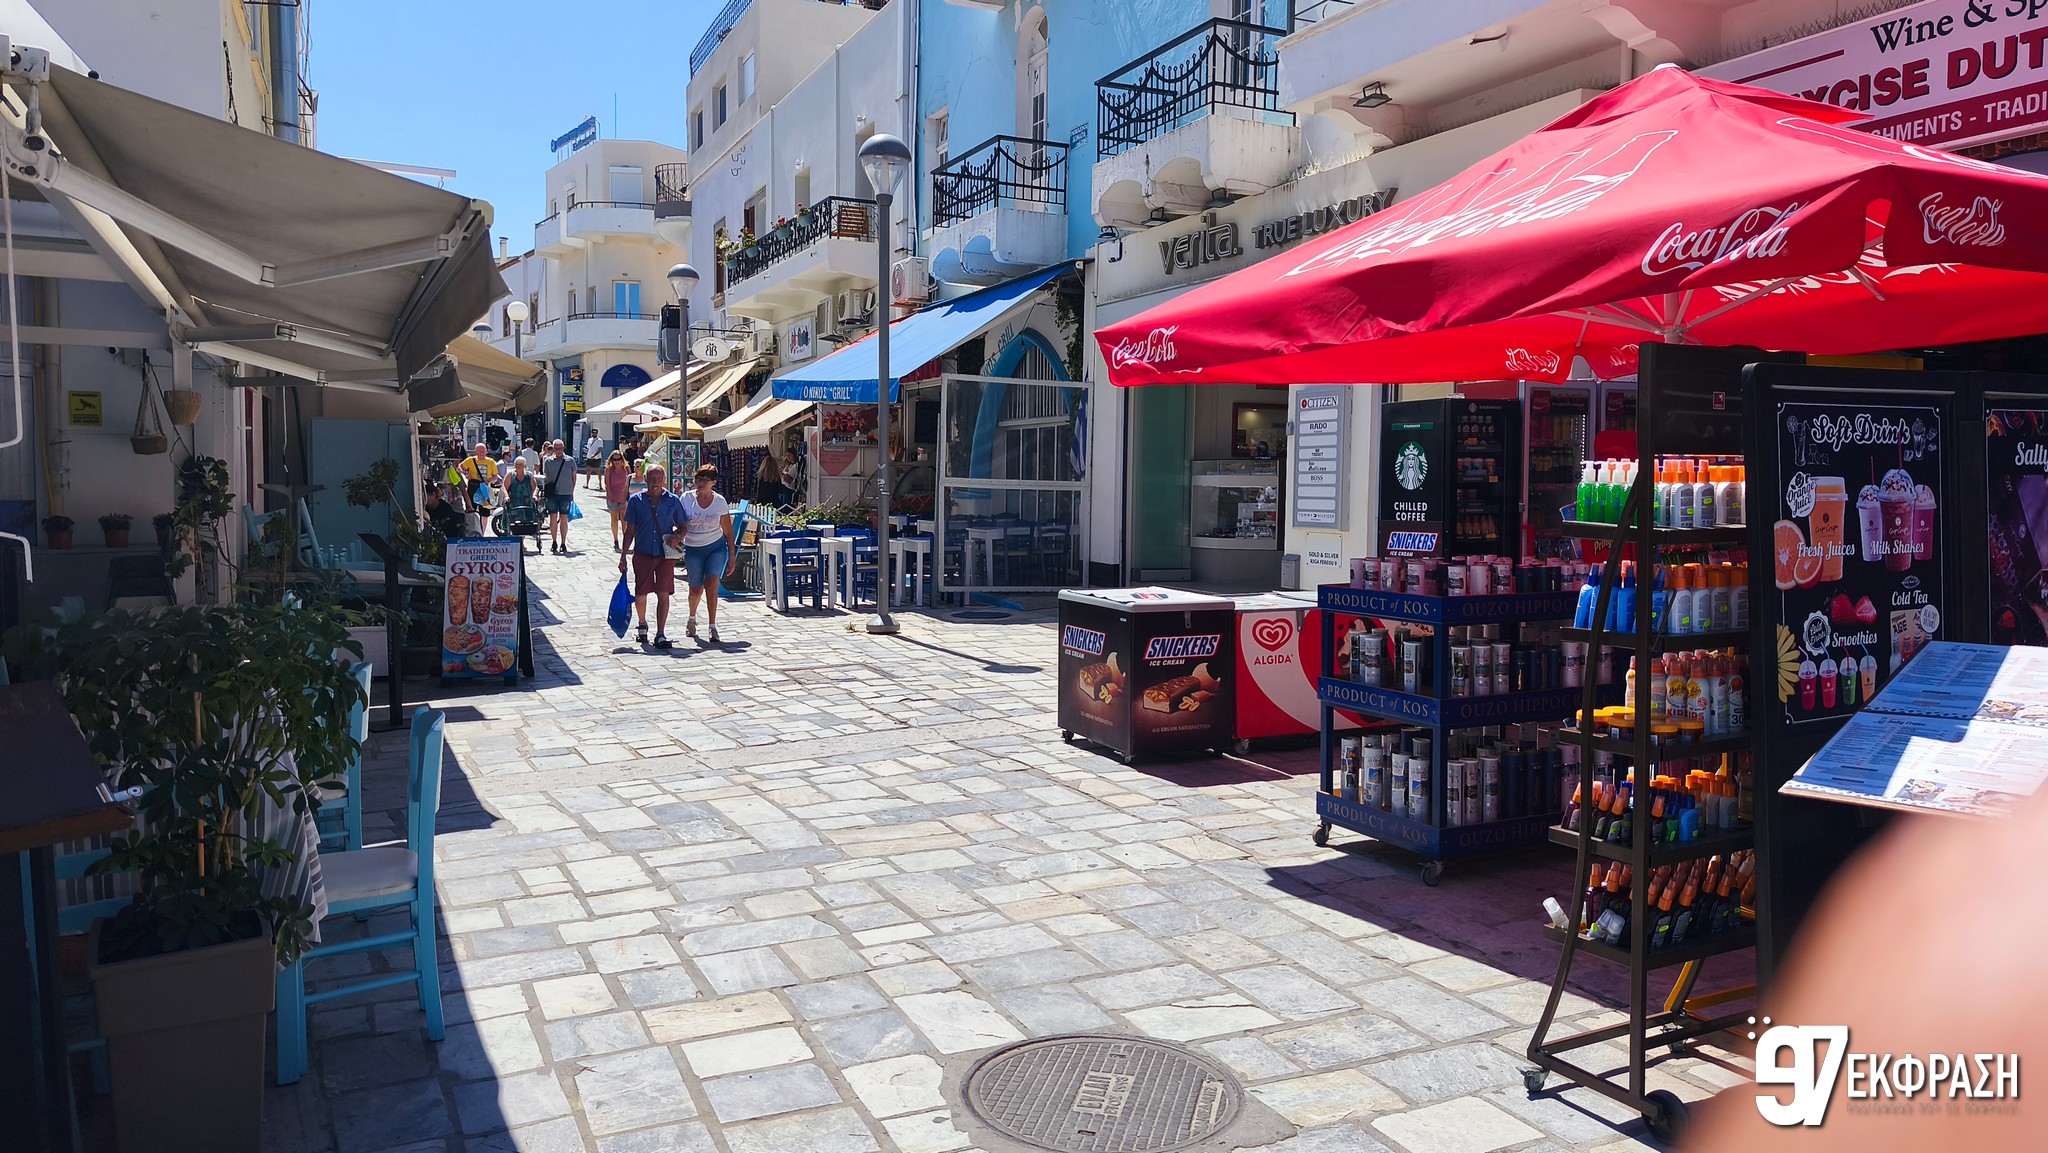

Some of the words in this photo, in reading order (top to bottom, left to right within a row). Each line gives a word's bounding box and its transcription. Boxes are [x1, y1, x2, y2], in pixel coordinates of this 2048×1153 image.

[1870, 15, 1953, 53] Wine
[1963, 0, 1997, 28] &
[1251, 216, 1300, 249] TRUE
[1302, 188, 1398, 236] LUXURY
[1642, 202, 1808, 275] Coca-Cola
[1112, 325, 1179, 369] Coca-Cola
[1308, 396, 1337, 408] CITIZEN
[1811, 414, 1853, 452] Soft
[1854, 413, 1911, 445] Drink
[1789, 480, 1816, 502] Orange
[1394, 501, 1428, 511] CHILLED
[1793, 493, 1812, 515] Juice
[1395, 512, 1426, 522] COFFEE
[1389, 532, 1436, 551] SNICKERS
[1797, 542, 1824, 557] Fresh
[1826, 541, 1855, 560] Juices
[1870, 540, 1891, 555] Milk
[1892, 539, 1924, 555] Shakes
[457, 547, 510, 555] TRADITIONAL
[451, 561, 515, 575] GYROS
[1327, 592, 1387, 611] PRODUCT
[1390, 599, 1399, 612] of
[1404, 600, 1429, 616] KOS
[1892, 591, 1911, 605] Cold
[1912, 590, 1928, 604] Tea
[1462, 601, 1510, 617] OUZO
[488, 625, 511, 633] Plates
[490, 617, 513, 625] Gyros
[1063, 626, 1105, 655] SNICKERS
[1148, 635, 1219, 658] SNICKERS
[1831, 630, 1878, 648] Smoothies
[1072, 650, 1085, 659] CREAM
[1162, 658, 1185, 666] CREAM
[1254, 654, 1292, 666] ALGIDA
[1327, 685, 1386, 708] PRODUCT
[1390, 697, 1400, 711] of
[1403, 699, 1428, 717] KOS
[1461, 701, 1508, 718] OUZO
[1731, 714, 1743, 725] 30
[1327, 802, 1386, 831] PRODUCT
[1402, 826, 1428, 845] KOS
[1460, 828, 1506, 847] OUZO
